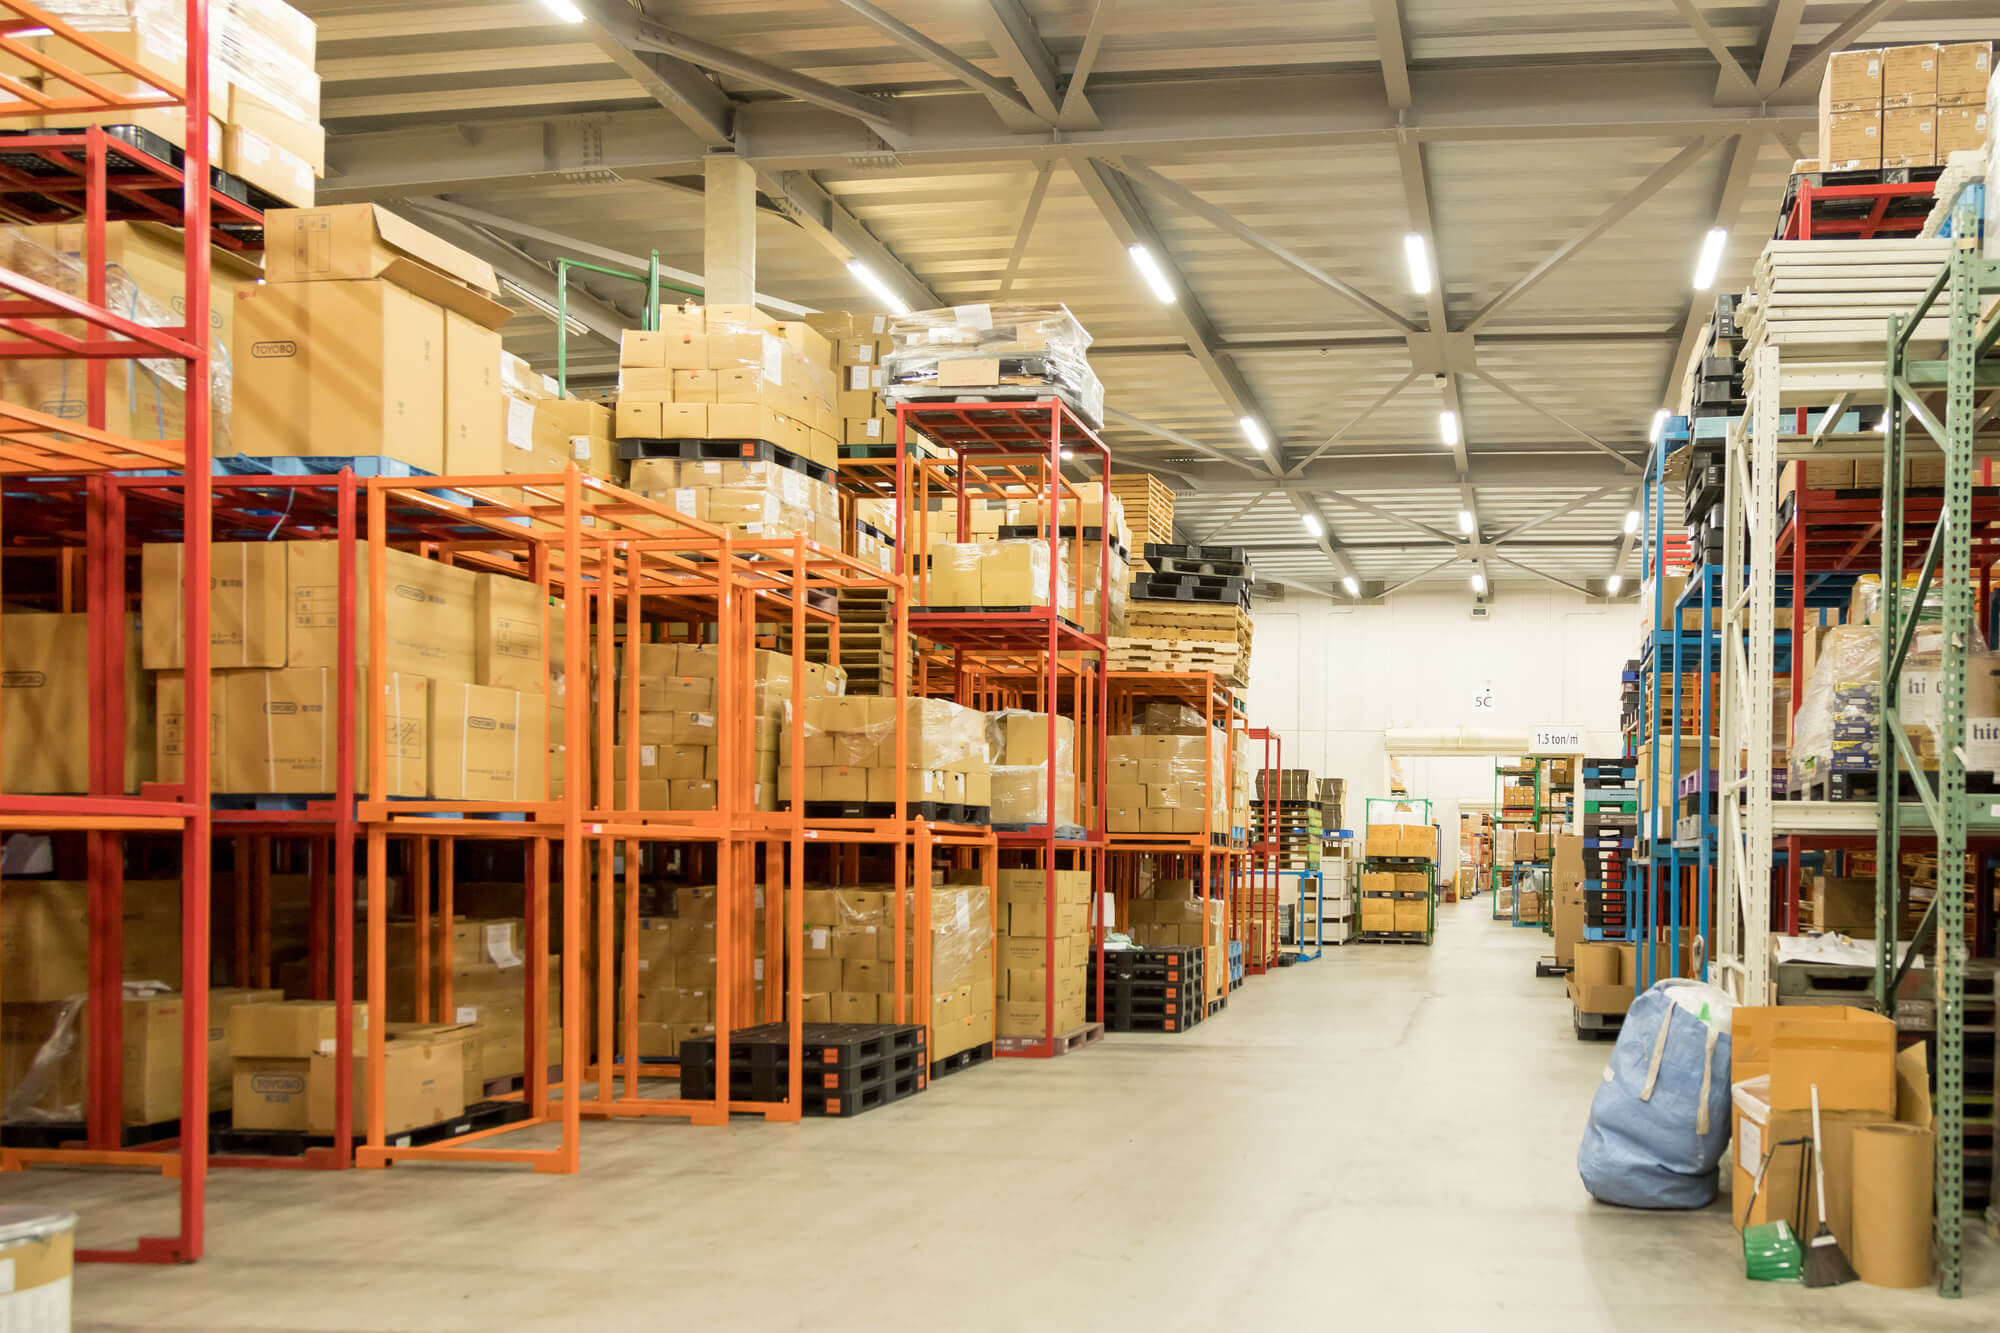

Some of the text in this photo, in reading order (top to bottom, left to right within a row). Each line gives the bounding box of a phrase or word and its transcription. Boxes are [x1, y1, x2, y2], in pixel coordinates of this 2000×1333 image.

[256, 344, 293, 354] TOYOBO
[1474, 696, 1492, 708] 5C
[1537, 733, 1550, 745] 1.5
